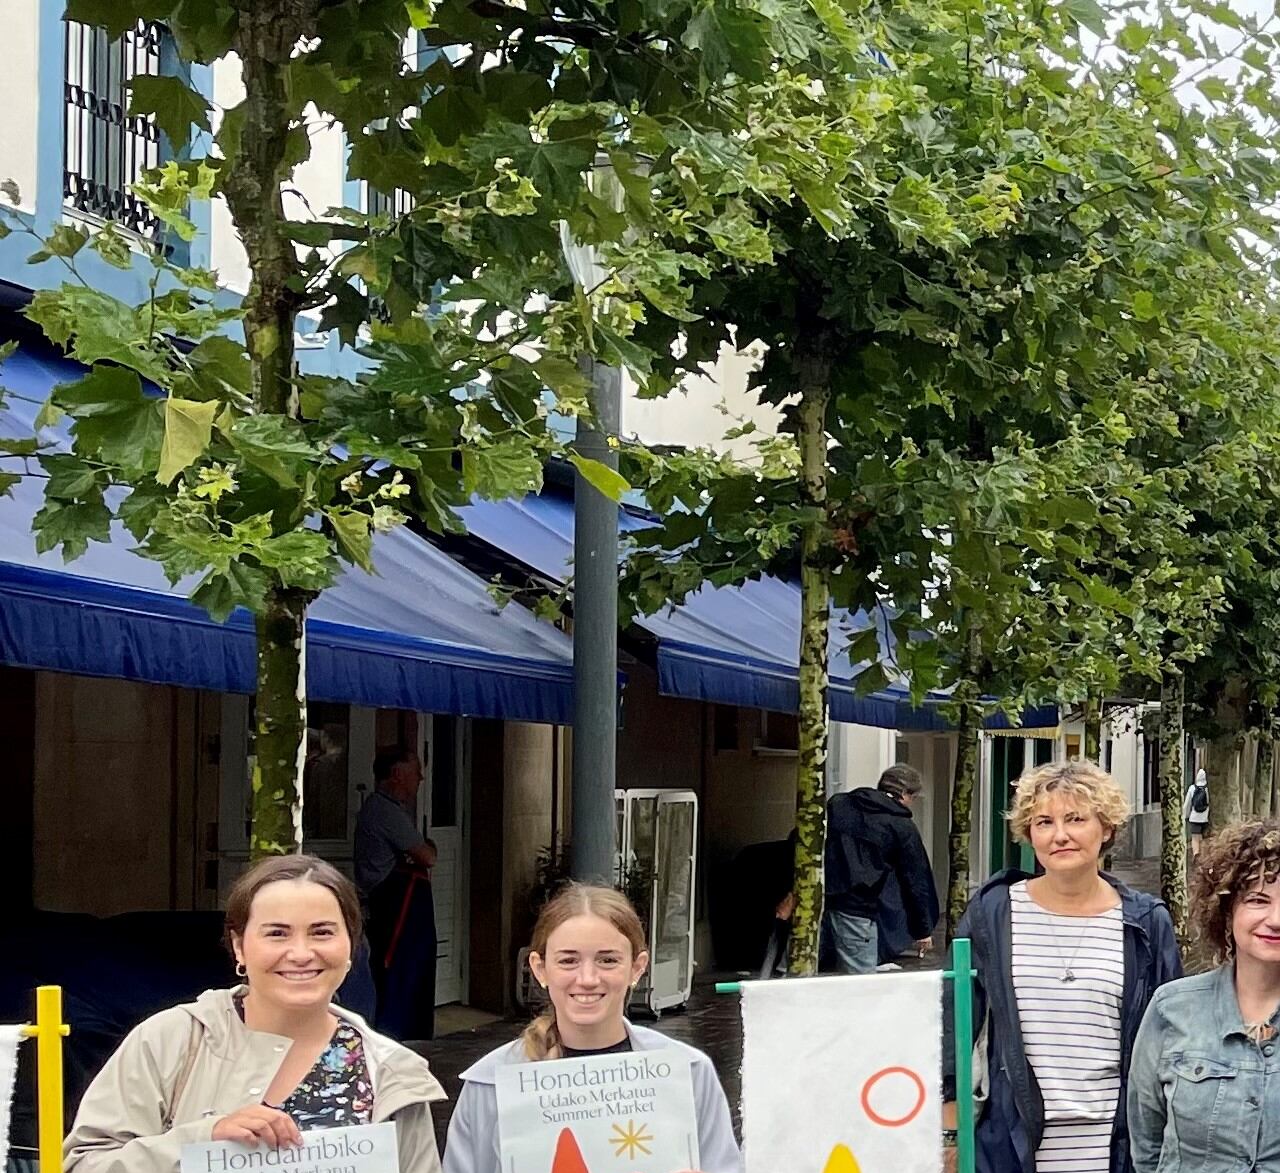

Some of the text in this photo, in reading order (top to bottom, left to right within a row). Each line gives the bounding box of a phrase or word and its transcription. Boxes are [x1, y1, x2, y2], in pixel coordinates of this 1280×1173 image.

[518, 1058, 671, 1093] Hondarribiko
[539, 1087, 656, 1109] Udako Merkatua
[542, 1100, 654, 1124] Summer Market
[206, 1134, 374, 1173] Hondarribiko
